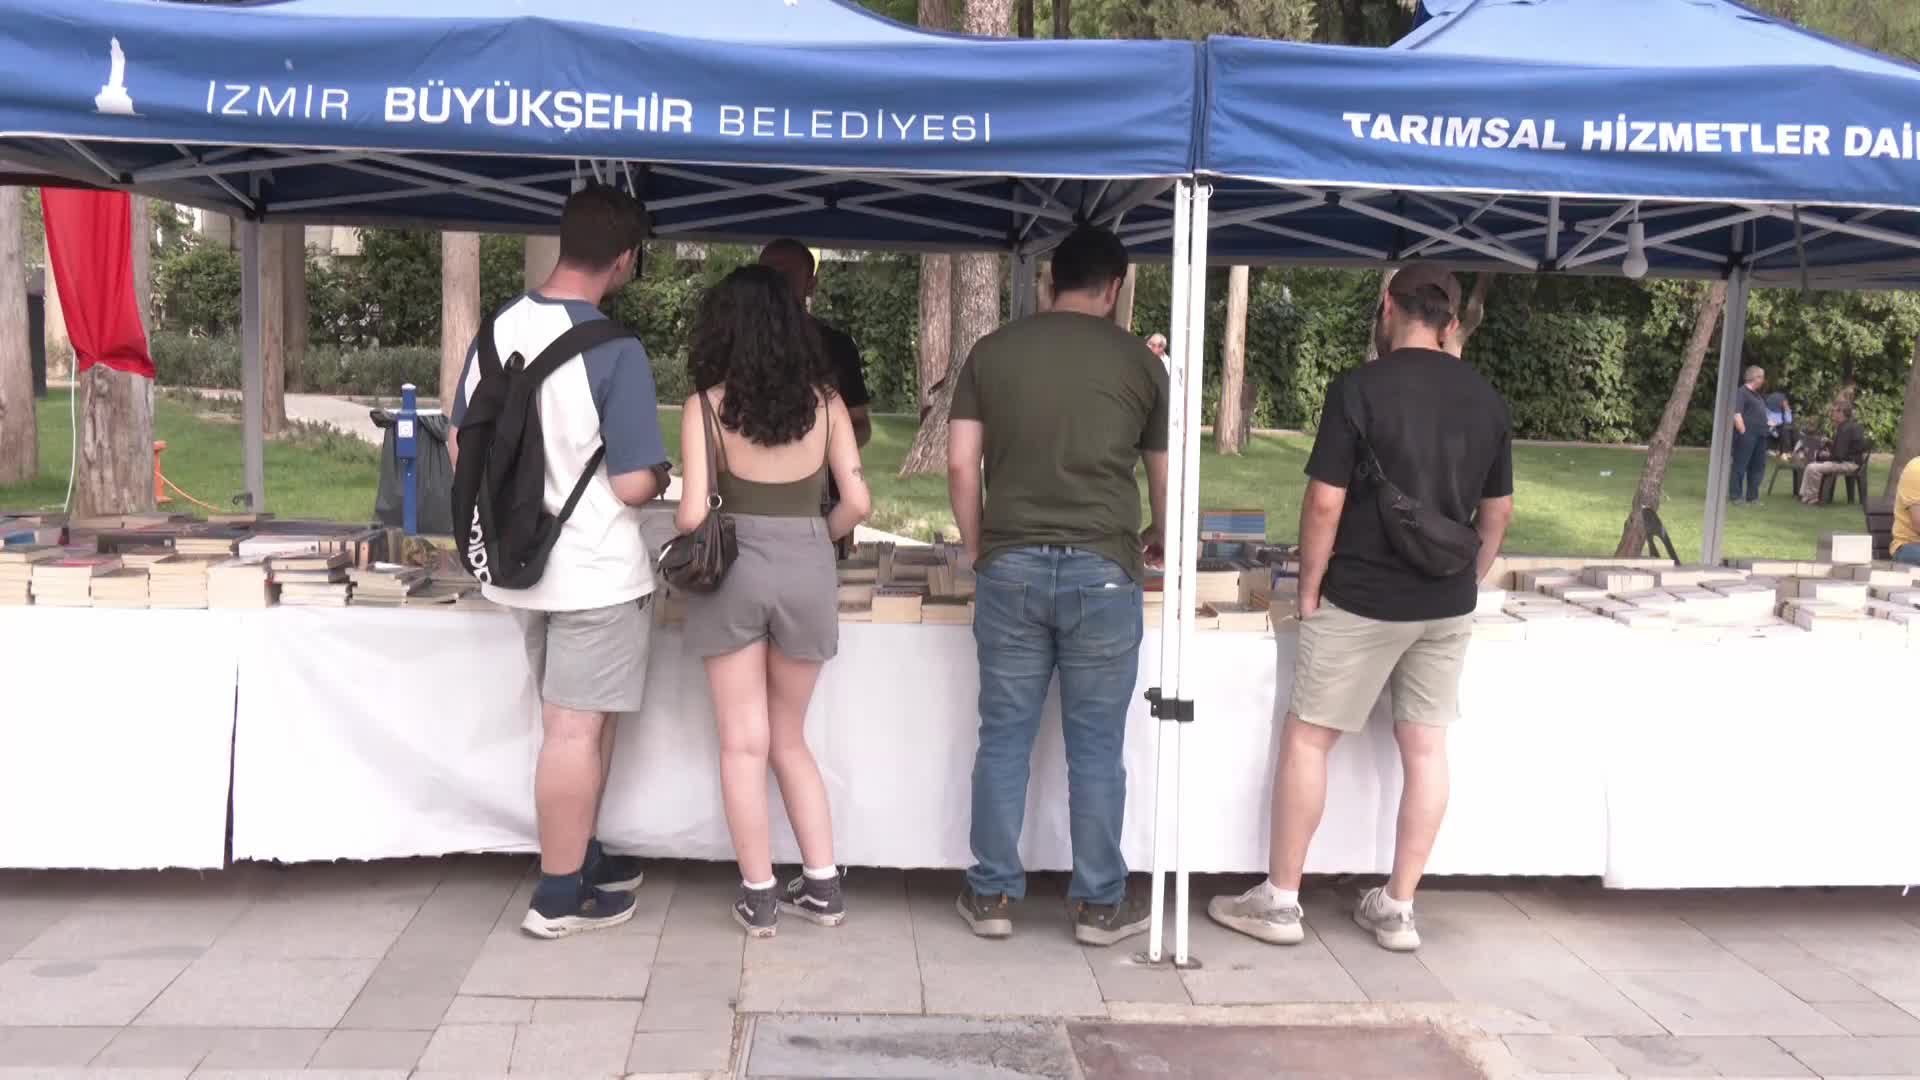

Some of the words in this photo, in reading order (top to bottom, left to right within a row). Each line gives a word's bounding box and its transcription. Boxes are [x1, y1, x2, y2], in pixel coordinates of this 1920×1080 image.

[384, 79, 693, 134] BÜYÜKŞEHİR
[719, 105, 991, 142] BELEDİYESİ
[1342, 112, 1566, 151] TARIMSAL
[1581, 113, 1831, 156] HİZMETLER
